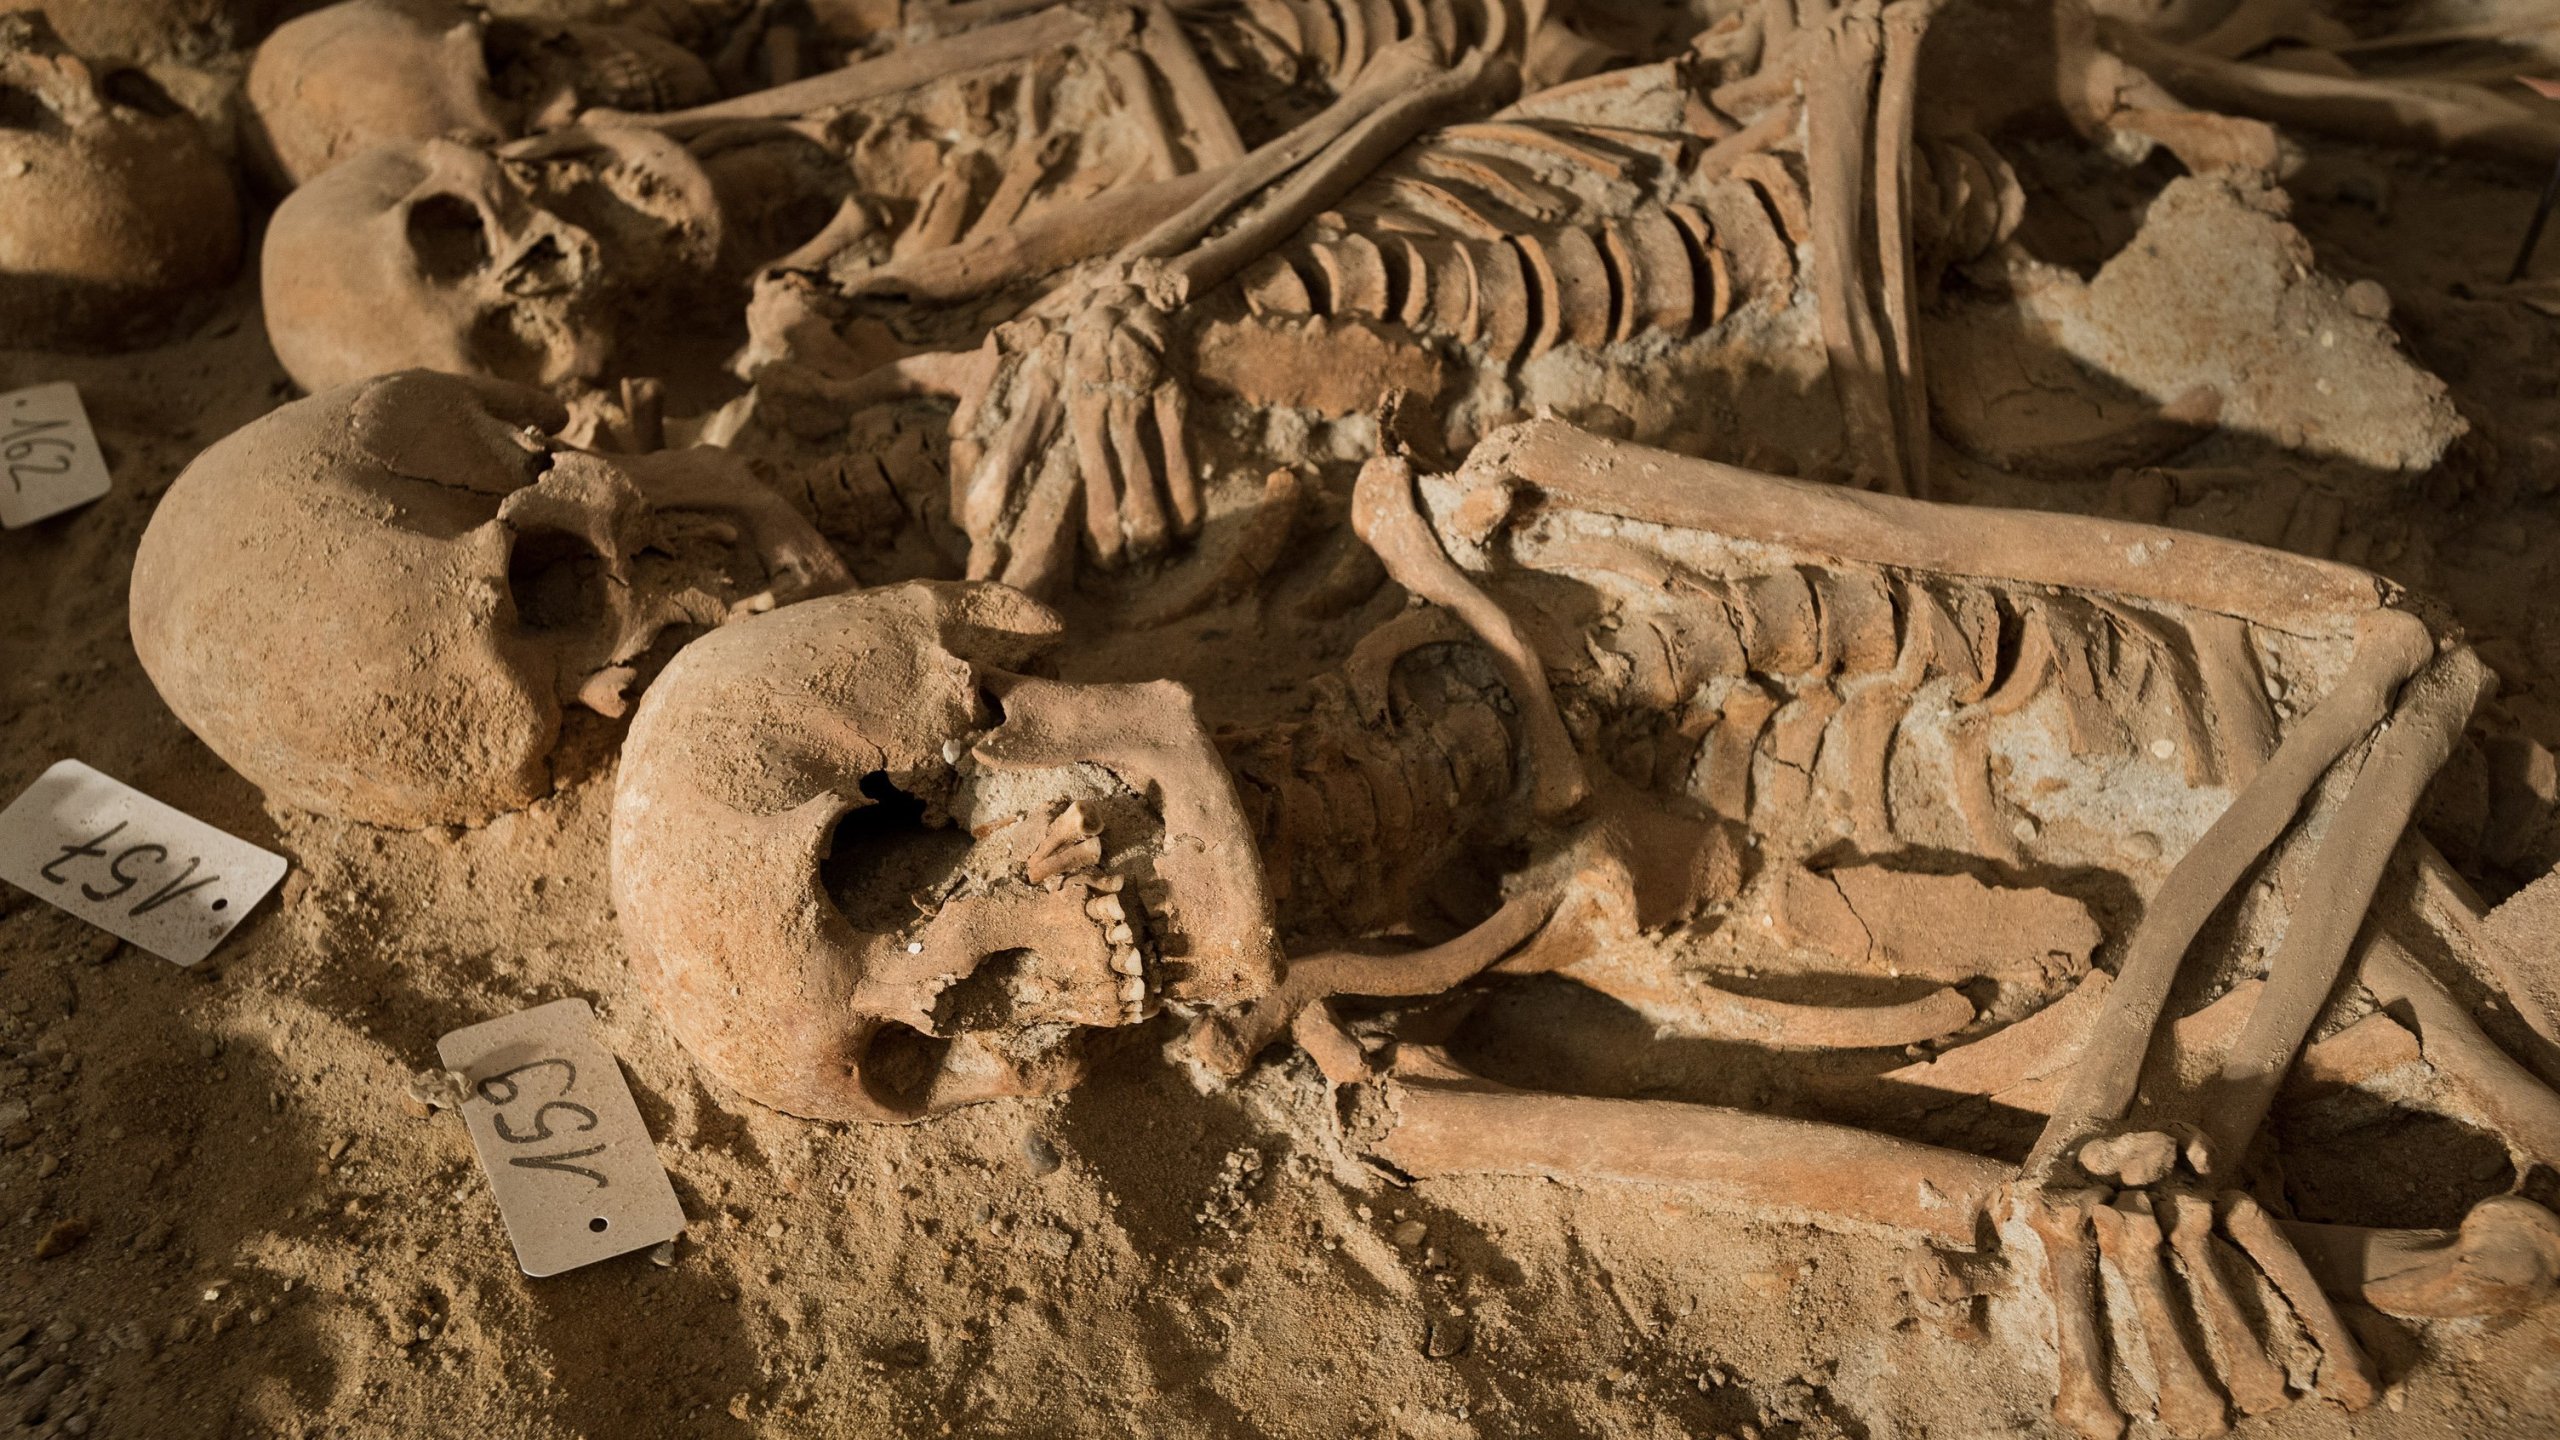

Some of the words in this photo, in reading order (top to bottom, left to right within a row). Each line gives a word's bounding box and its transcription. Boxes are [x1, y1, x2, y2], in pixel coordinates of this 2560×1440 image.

[1, 418, 77, 493] 162
[40, 821, 220, 917] 157
[477, 1058, 609, 1188] 159
